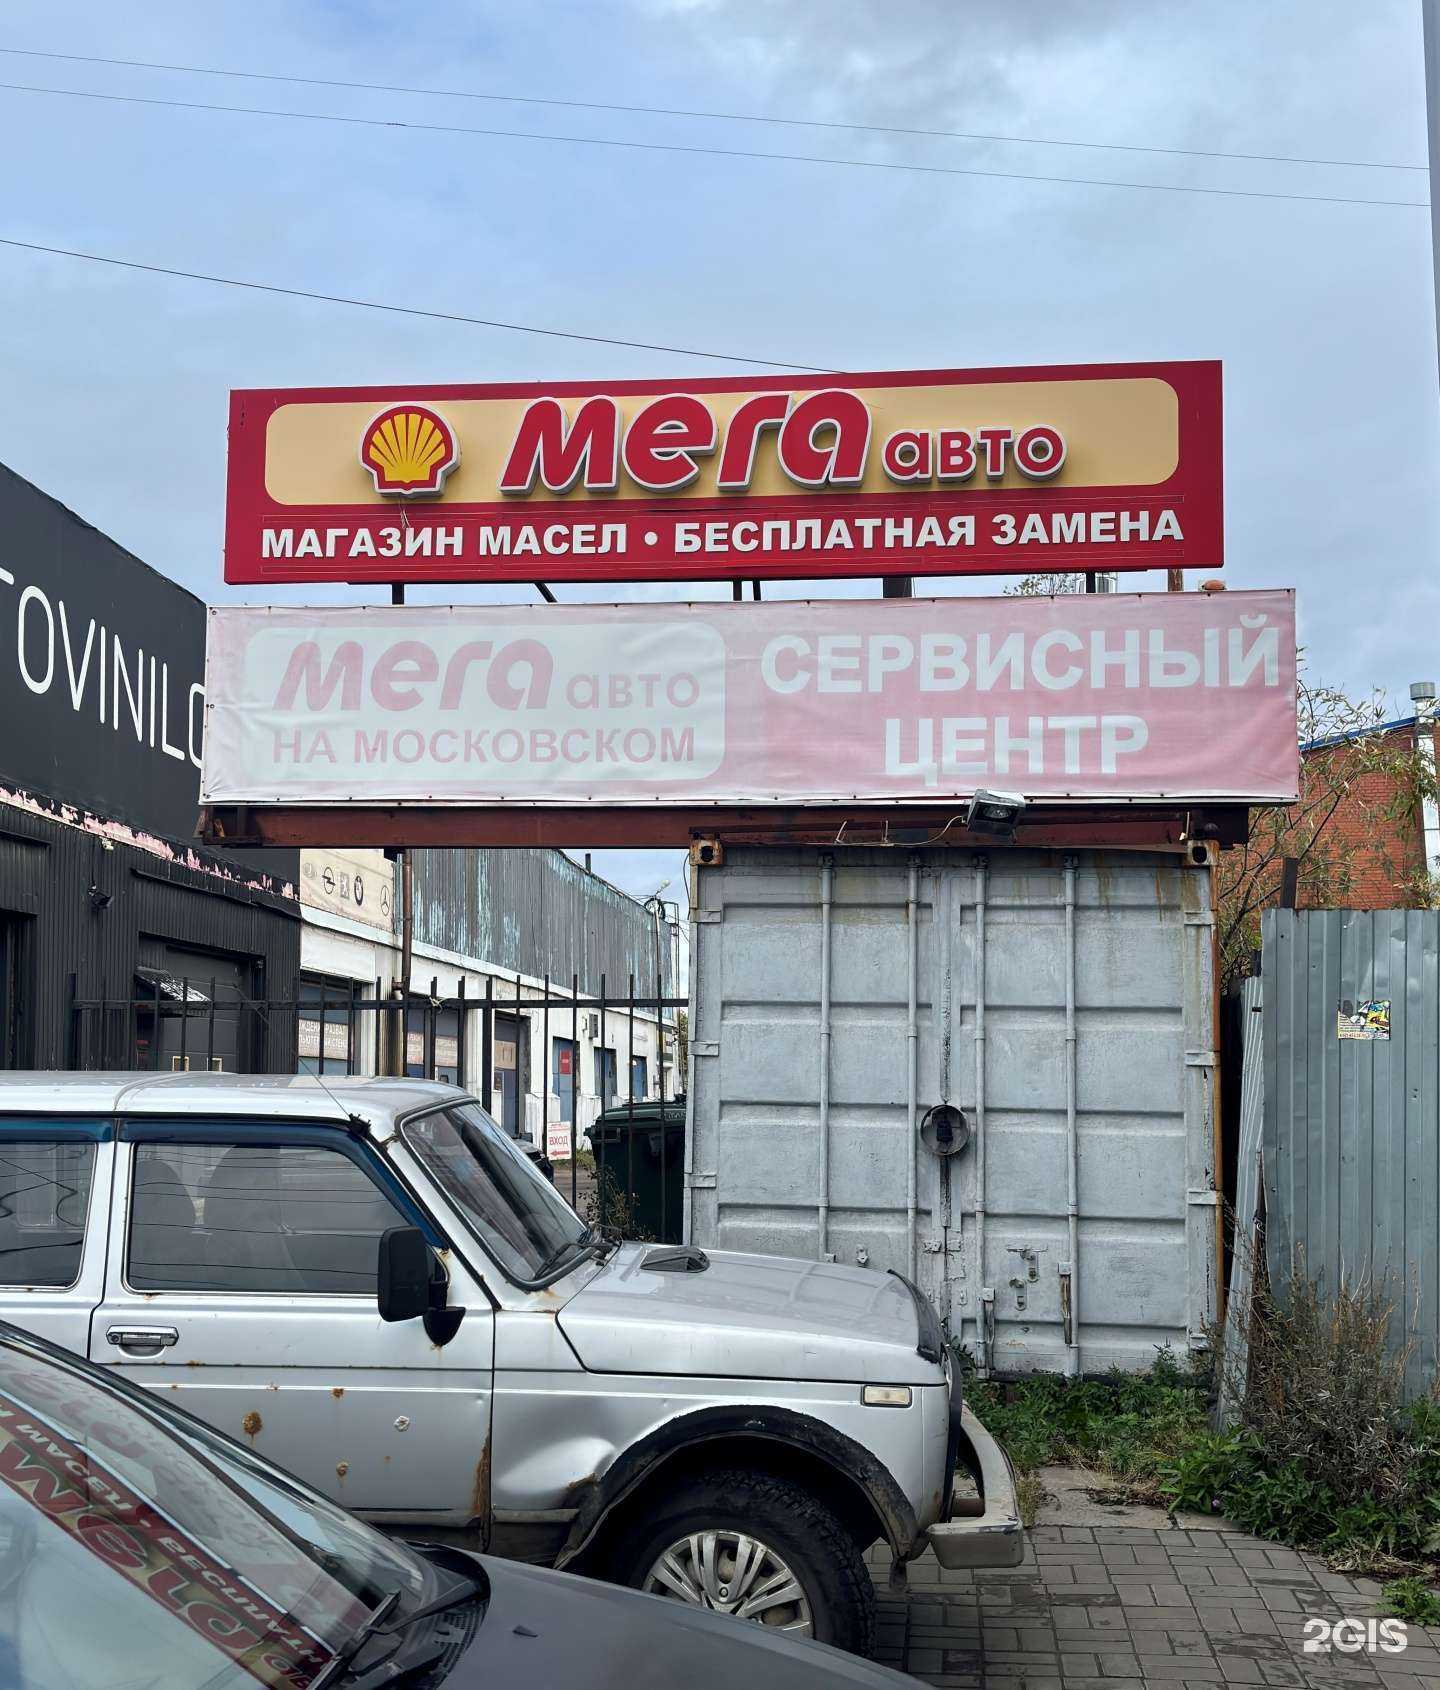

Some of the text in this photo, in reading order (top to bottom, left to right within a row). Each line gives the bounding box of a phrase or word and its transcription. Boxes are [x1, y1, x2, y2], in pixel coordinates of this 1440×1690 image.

[881, 424, 1068, 484] авто
[261, 509, 1185, 558] МАГАЗИН МАСЕЛ БЕСПЛАТНАЯ ЗАМЕНА
[760, 613, 1281, 694] СЕРВИСНЫЙ
[565, 671, 701, 710] авто
[272, 727, 695, 764] НА МОСКОВСКОМ
[884, 714, 1149, 786] ЦЕНТР
[548, 1135, 569, 1147] ВХОД
